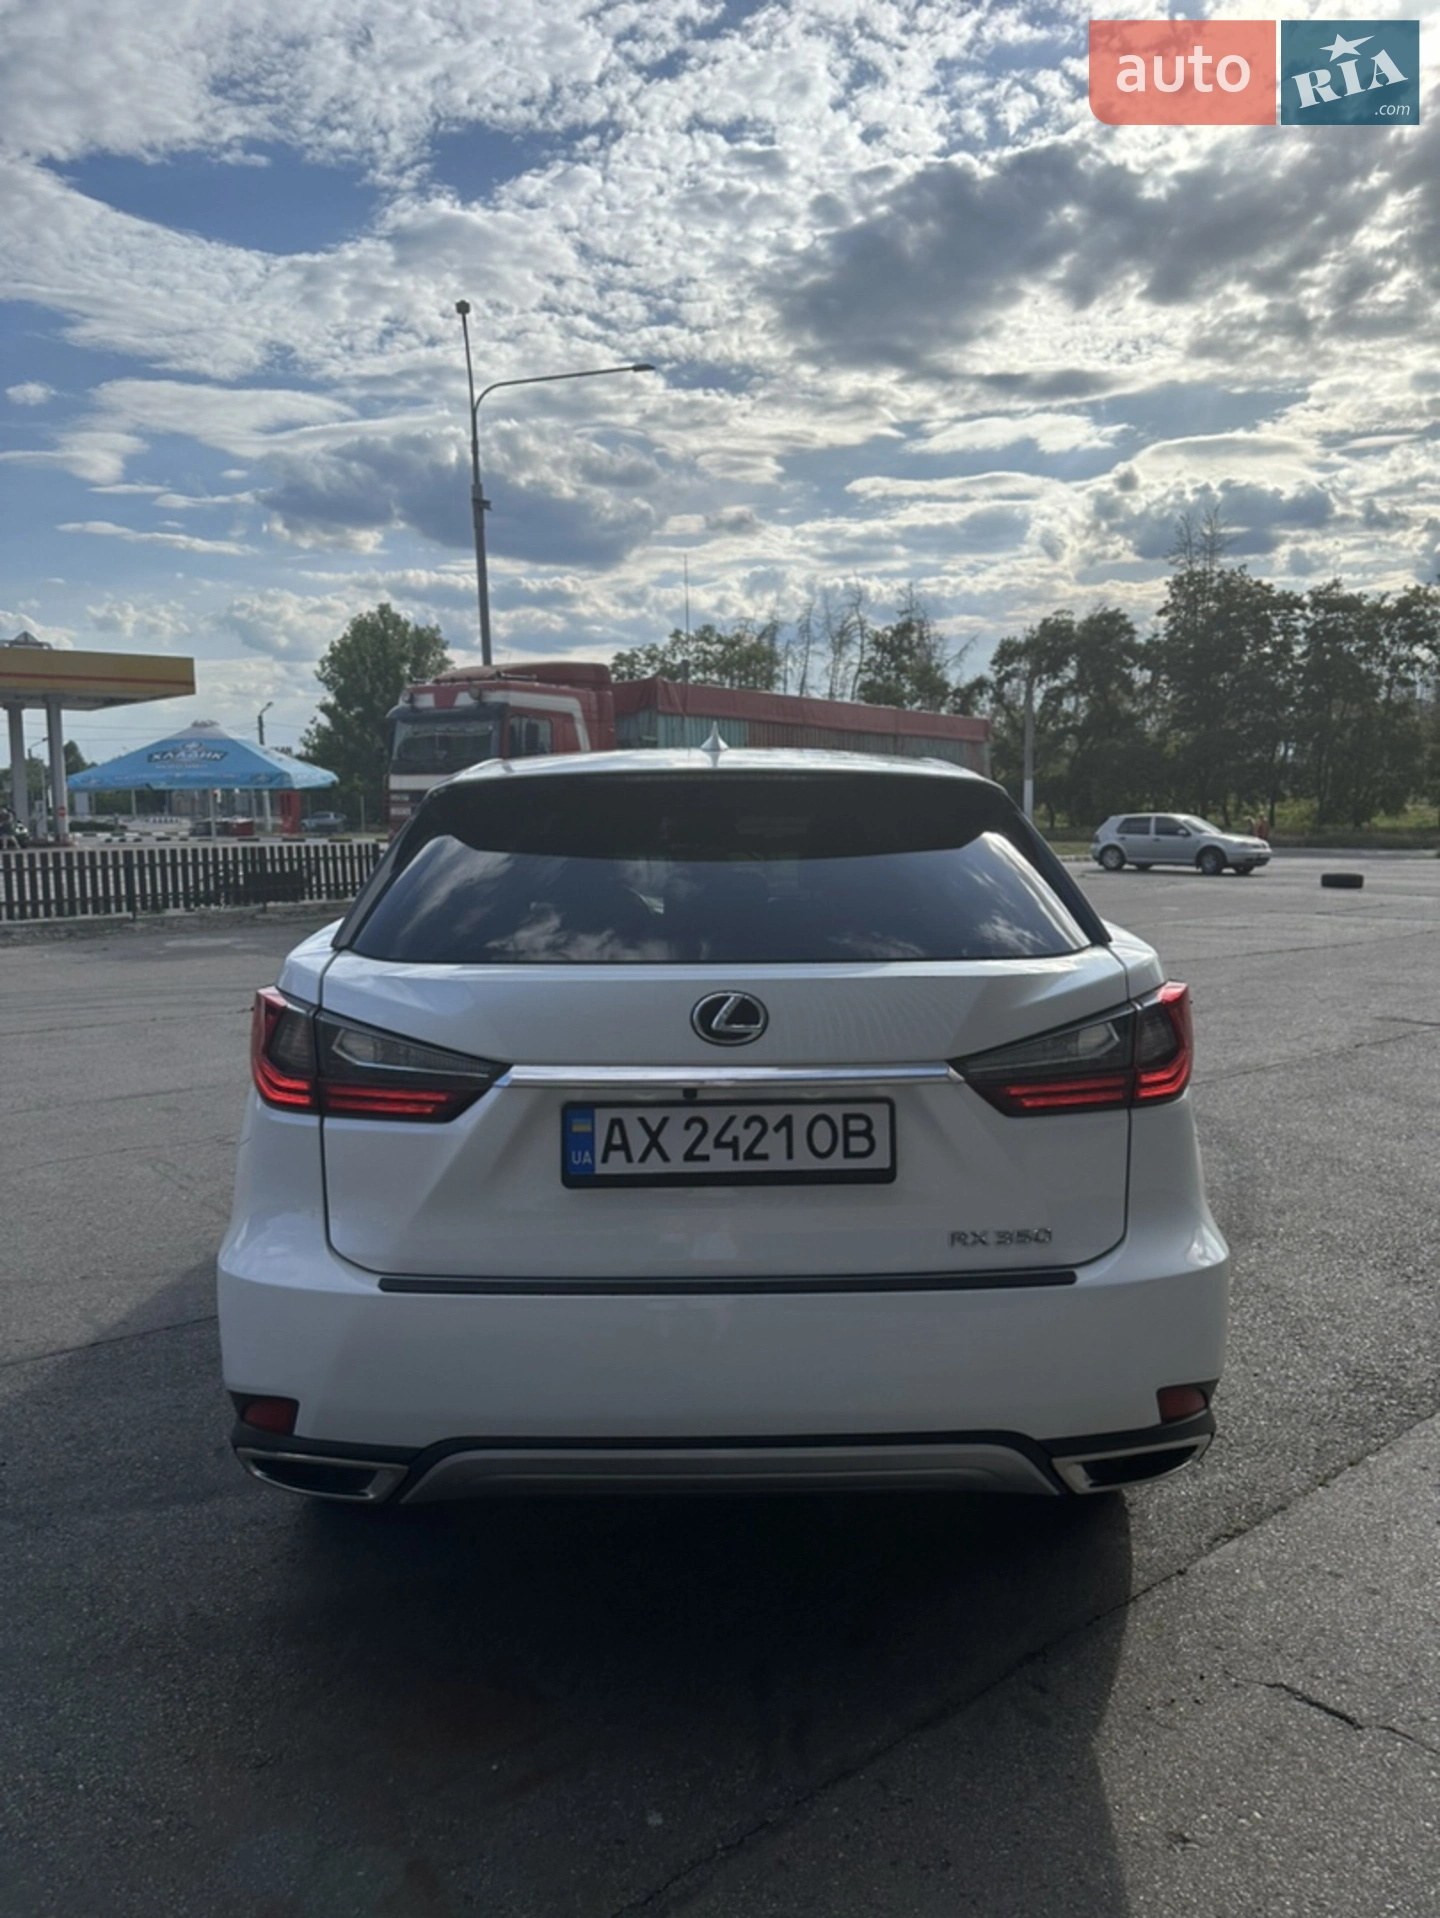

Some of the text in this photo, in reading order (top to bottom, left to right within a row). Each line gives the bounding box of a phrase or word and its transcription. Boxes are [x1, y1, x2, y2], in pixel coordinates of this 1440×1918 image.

[600, 1112, 876, 1164] AX 2421 OB
[571, 1150, 592, 1165] UA
[949, 1227, 1052, 1247] RX 350
